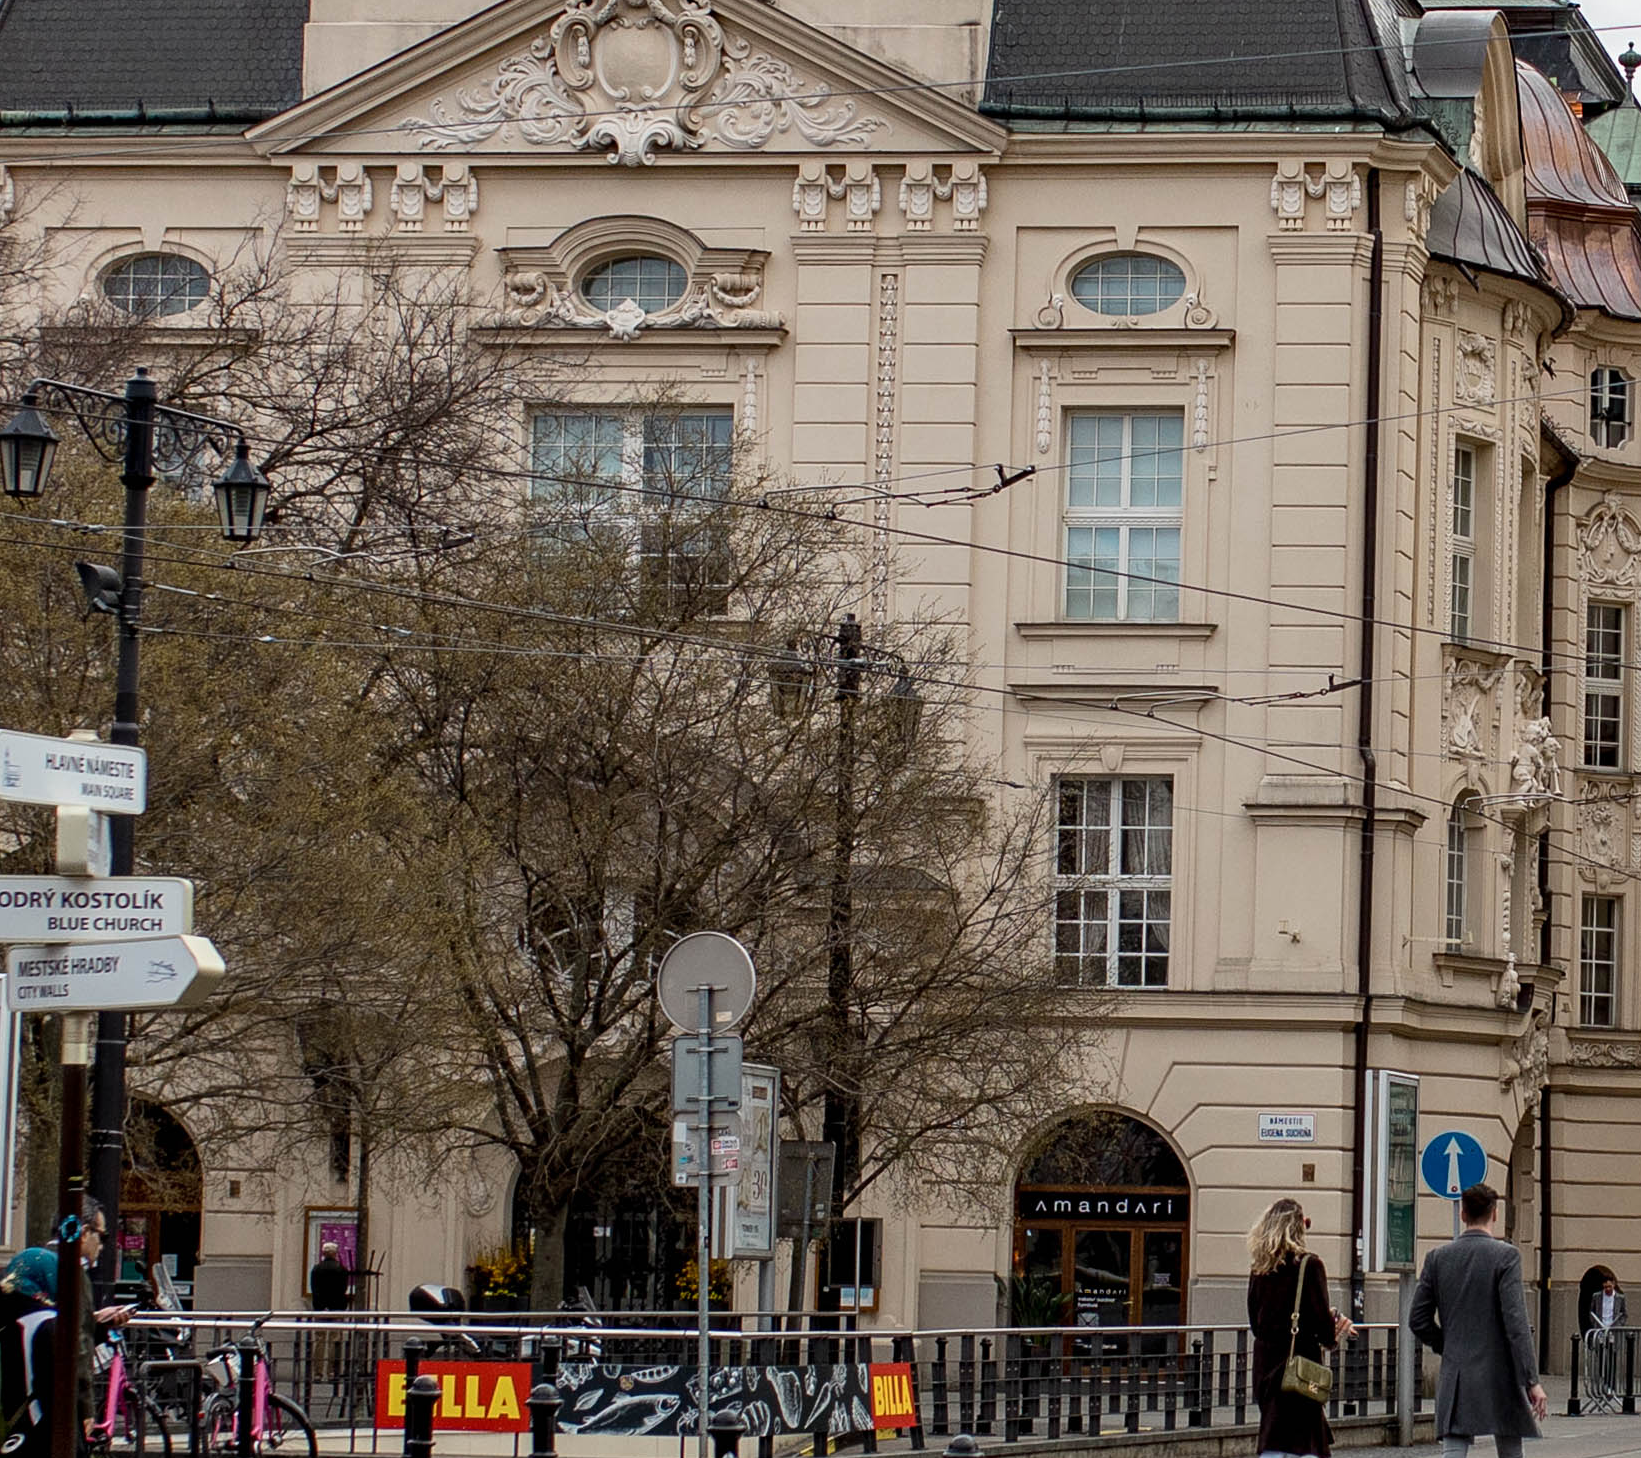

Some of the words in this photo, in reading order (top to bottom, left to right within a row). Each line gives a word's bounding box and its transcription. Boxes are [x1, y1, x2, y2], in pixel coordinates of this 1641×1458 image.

[45, 752, 85, 774] HLAVNÉ
[86, 755, 135, 779] NÁMESTIE
[81, 782, 102, 797] MAIN
[103, 785, 135, 801] SQUARE
[60, 889, 164, 910] KOSTOLÍK
[47, 917, 90, 931] BLUE
[93, 917, 163, 932] CHURCH
[17, 956, 70, 978] MESTSKÉ
[71, 956, 120, 974] HRADBY
[17, 986, 38, 1000] CITY
[38, 984, 69, 998] WALLS
[387, 1373, 521, 1419] BLLA
[873, 1375, 913, 1416] BILLA
